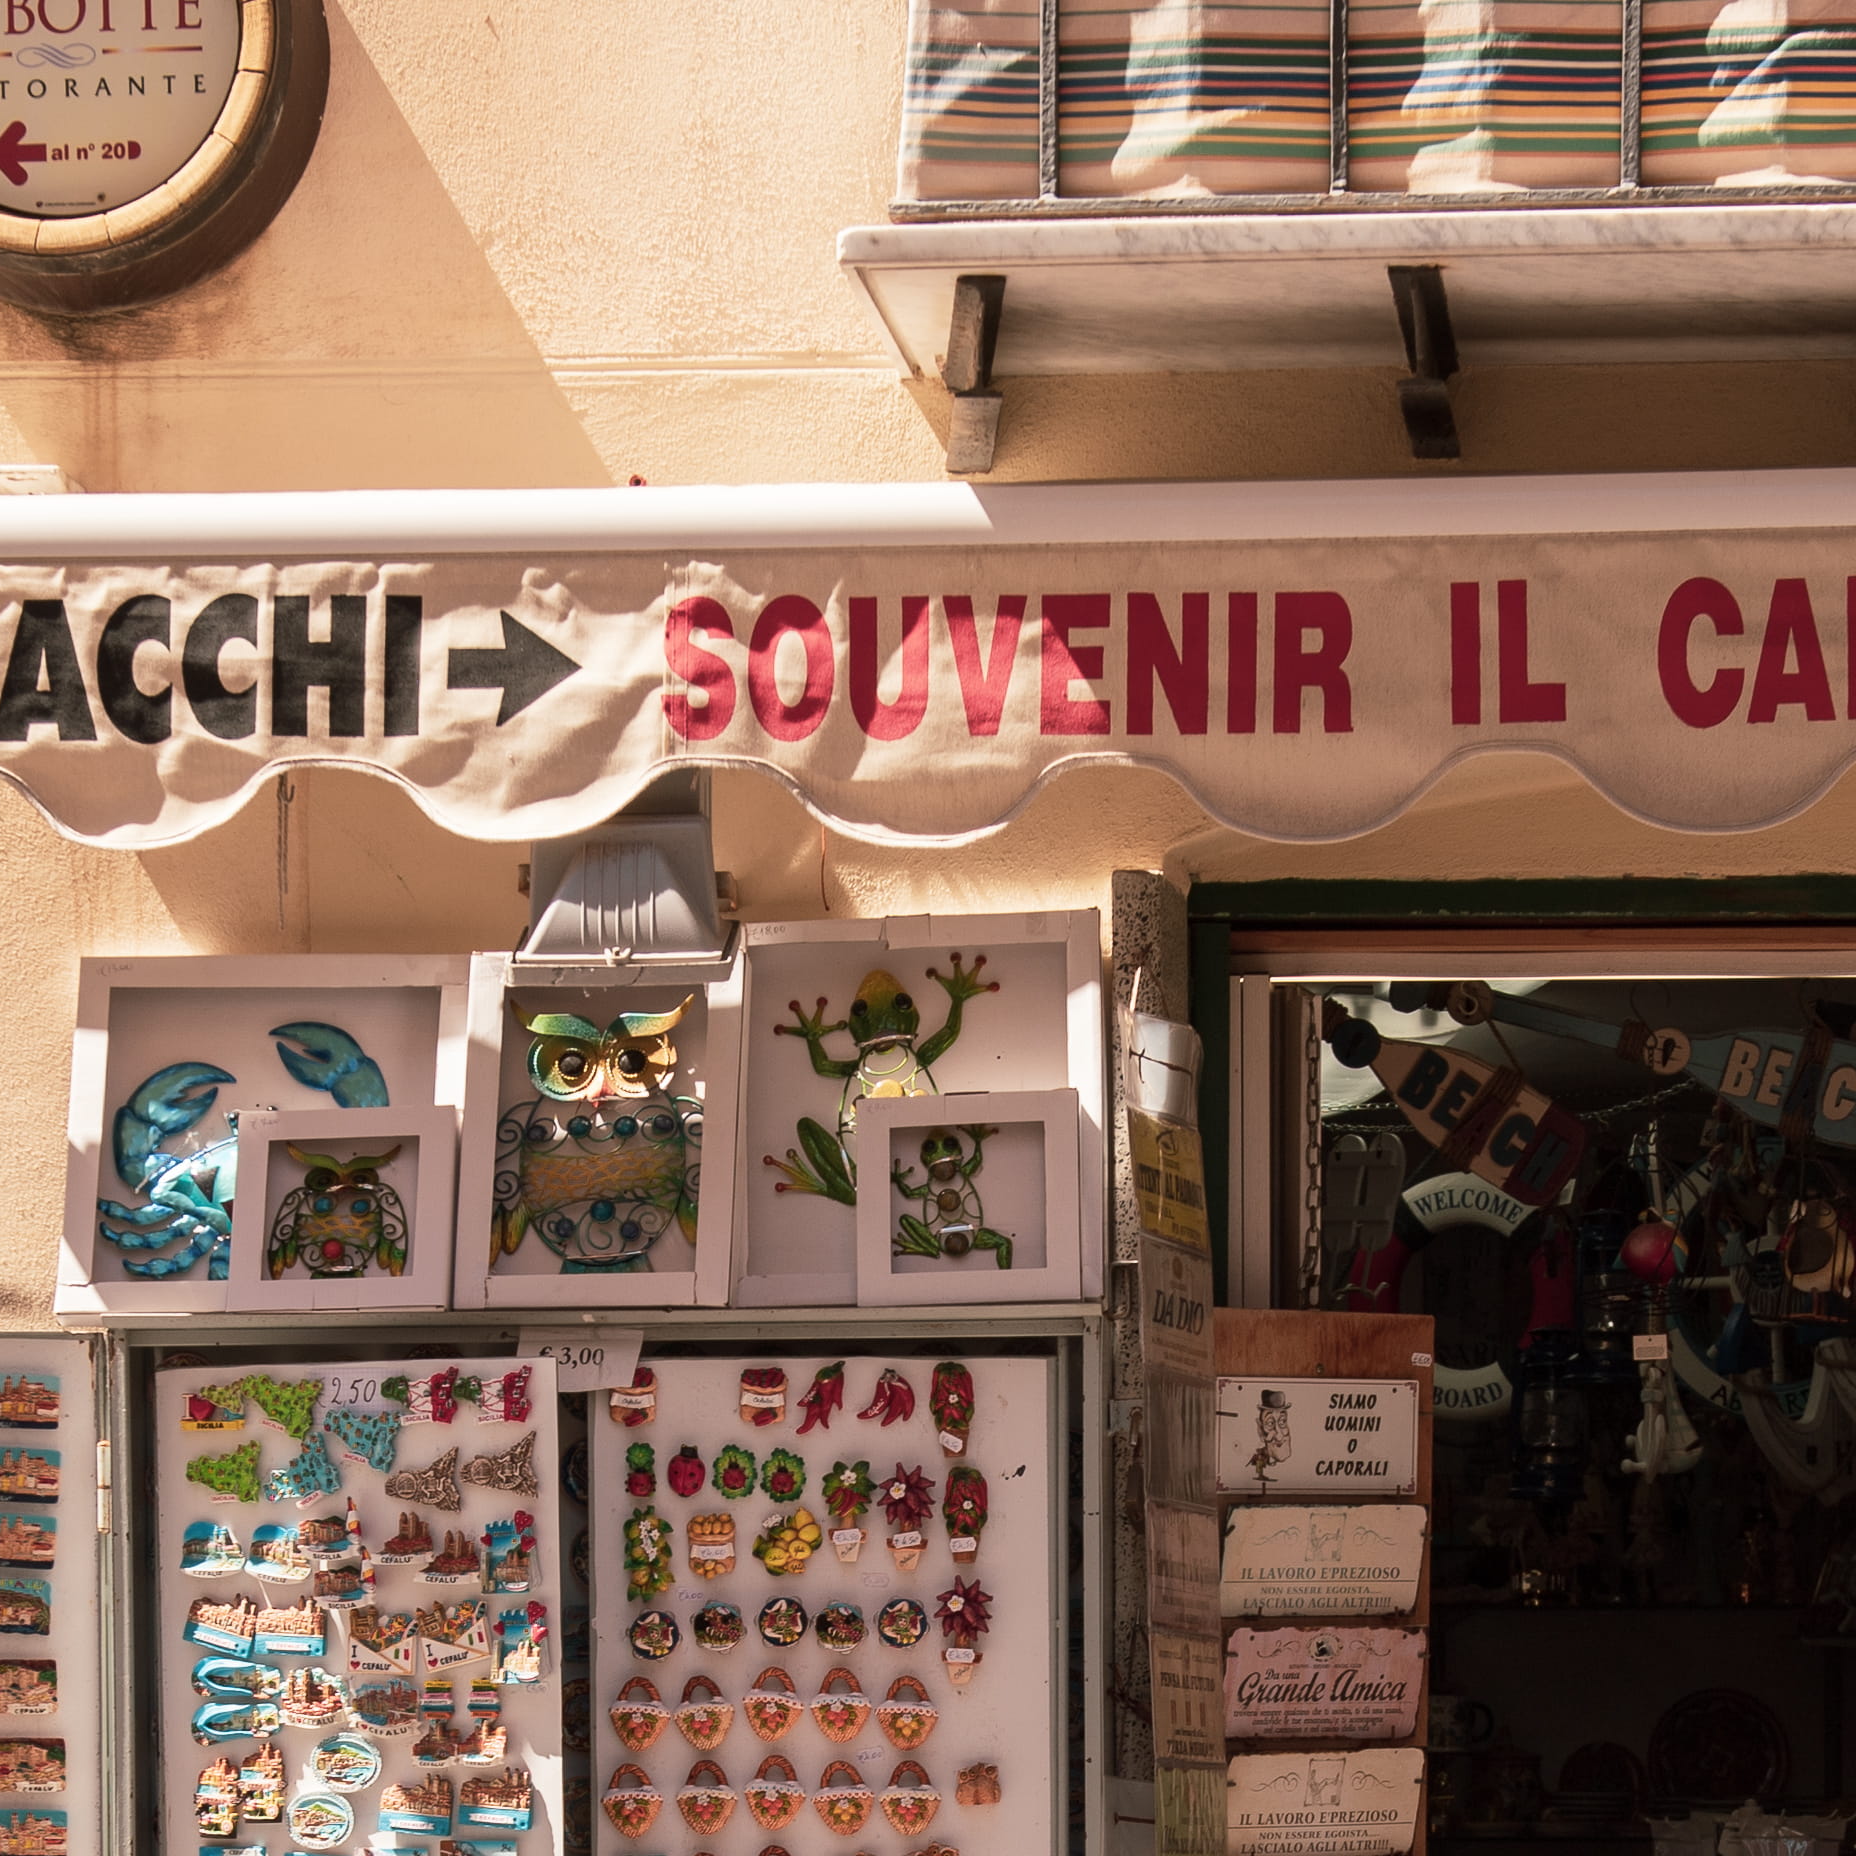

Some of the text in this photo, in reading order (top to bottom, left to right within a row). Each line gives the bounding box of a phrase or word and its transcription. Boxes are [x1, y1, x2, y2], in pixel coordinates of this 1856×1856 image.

[5, 0, 202, 36] BOTTE
[51, 144, 69, 161] al
[663, 588, 1354, 742] SOUVENIR
[1450, 579, 1568, 725] IL
[1415, 1188, 1524, 1226] WELCOME
[559, 1346, 605, 1366] 3,00
[1329, 1393, 1377, 1410] SIAMO
[196, 1422, 224, 1430] SICILIA
[1325, 1415, 1382, 1432] UOMINI
[1347, 1438, 1357, 1454] O
[1315, 1460, 1388, 1477] CAPORALI
[1241, 1567, 1253, 1580] IL
[1259, 1567, 1316, 1580] LAVORO
[1260, 1586, 1322, 1595] NON ESSERE
[1243, 1597, 1340, 1610] LASCIALO AGLI
[1264, 1668, 1300, 1680] Da una
[1237, 1671, 1326, 1706] Grande
[1330, 1669, 1408, 1702] Amica
[1240, 1814, 1253, 1825] IL
[1257, 1811, 1315, 1825] LAVORO
[1259, 1831, 1322, 1840] NON ESSERE
[1241, 1841, 1337, 1855] LASCIALO AGLI
